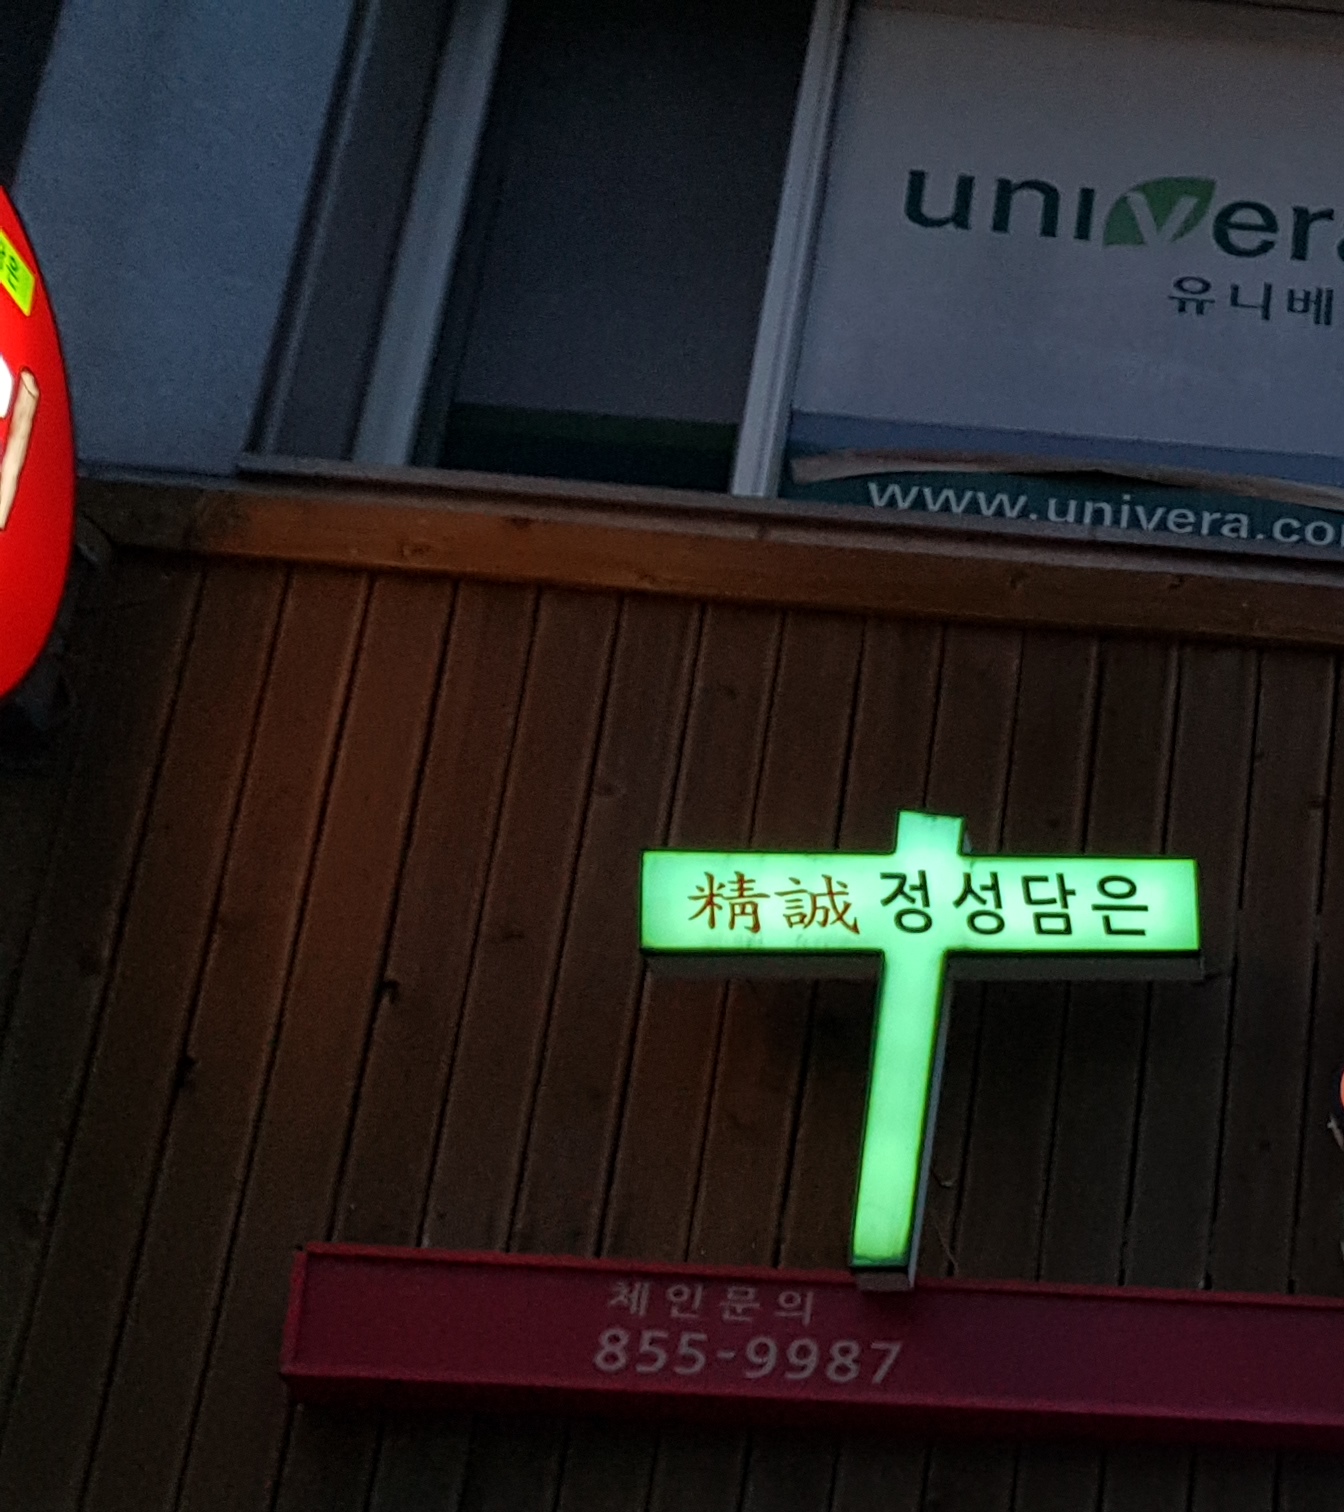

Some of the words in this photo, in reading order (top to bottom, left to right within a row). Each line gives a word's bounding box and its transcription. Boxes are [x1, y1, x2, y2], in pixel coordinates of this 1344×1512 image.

[688, 870, 860, 935] 精誠
[878, 870, 1150, 937] 정성담은
[609, 1279, 814, 1327] 체인문의
[594, 1327, 904, 1386] 855-9987
